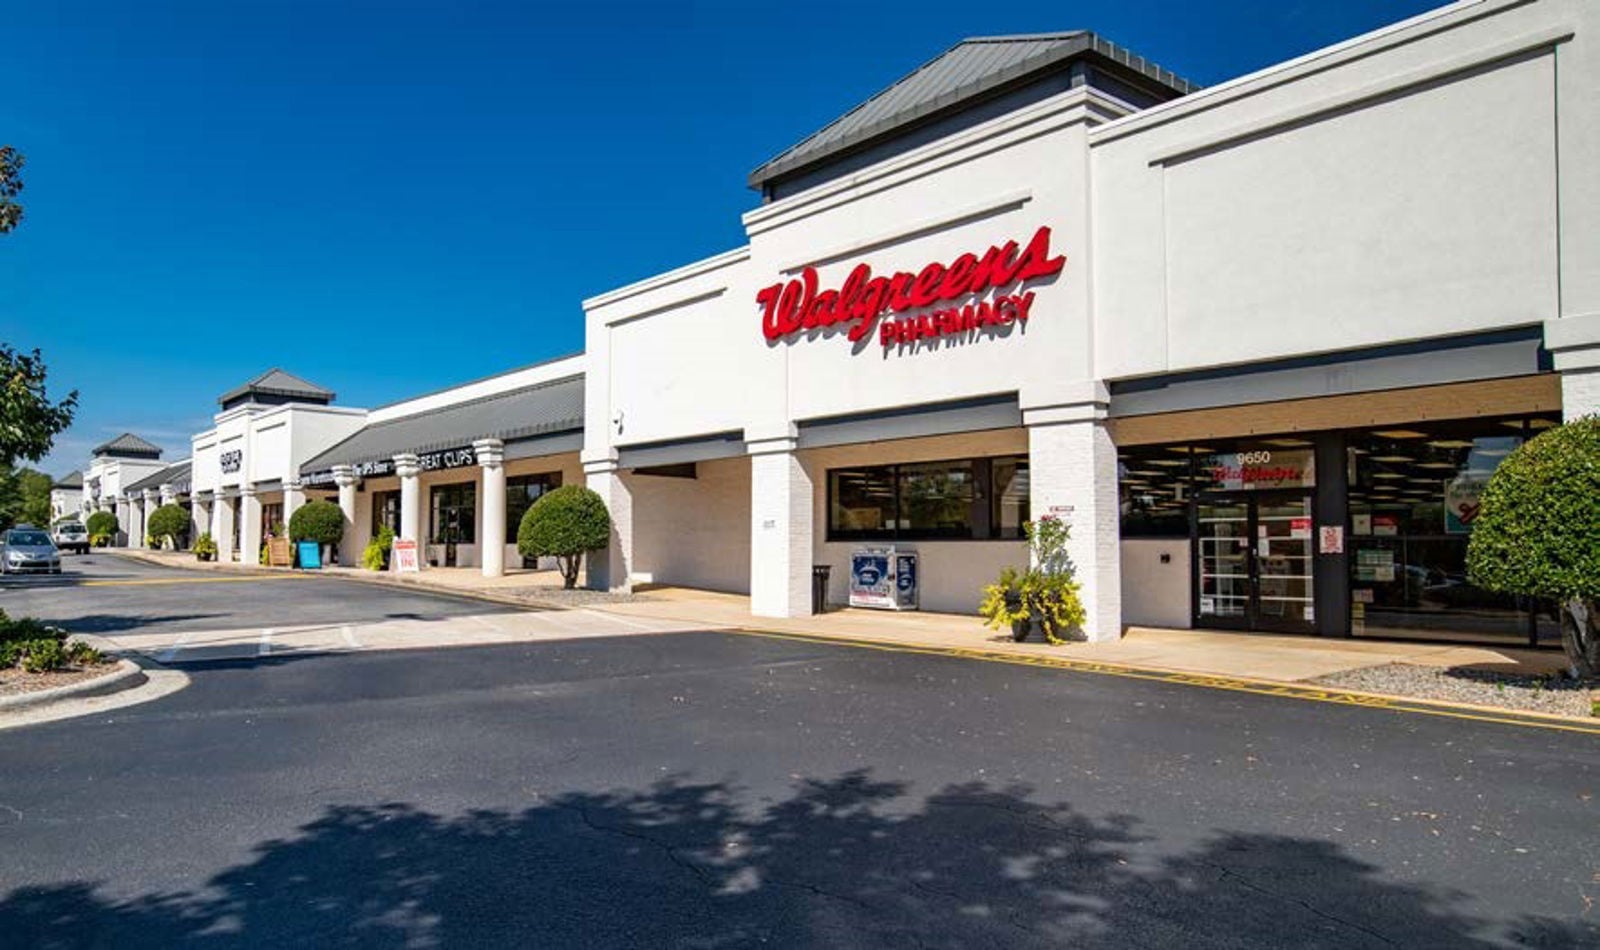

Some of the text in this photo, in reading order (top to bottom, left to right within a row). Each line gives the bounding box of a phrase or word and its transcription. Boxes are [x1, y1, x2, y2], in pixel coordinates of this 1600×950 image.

[756, 226, 1066, 342] Walgreens
[880, 291, 1036, 347] PHARMACY
[444, 449, 473, 467] CLIPS
[1236, 451, 1271, 465] 9650
